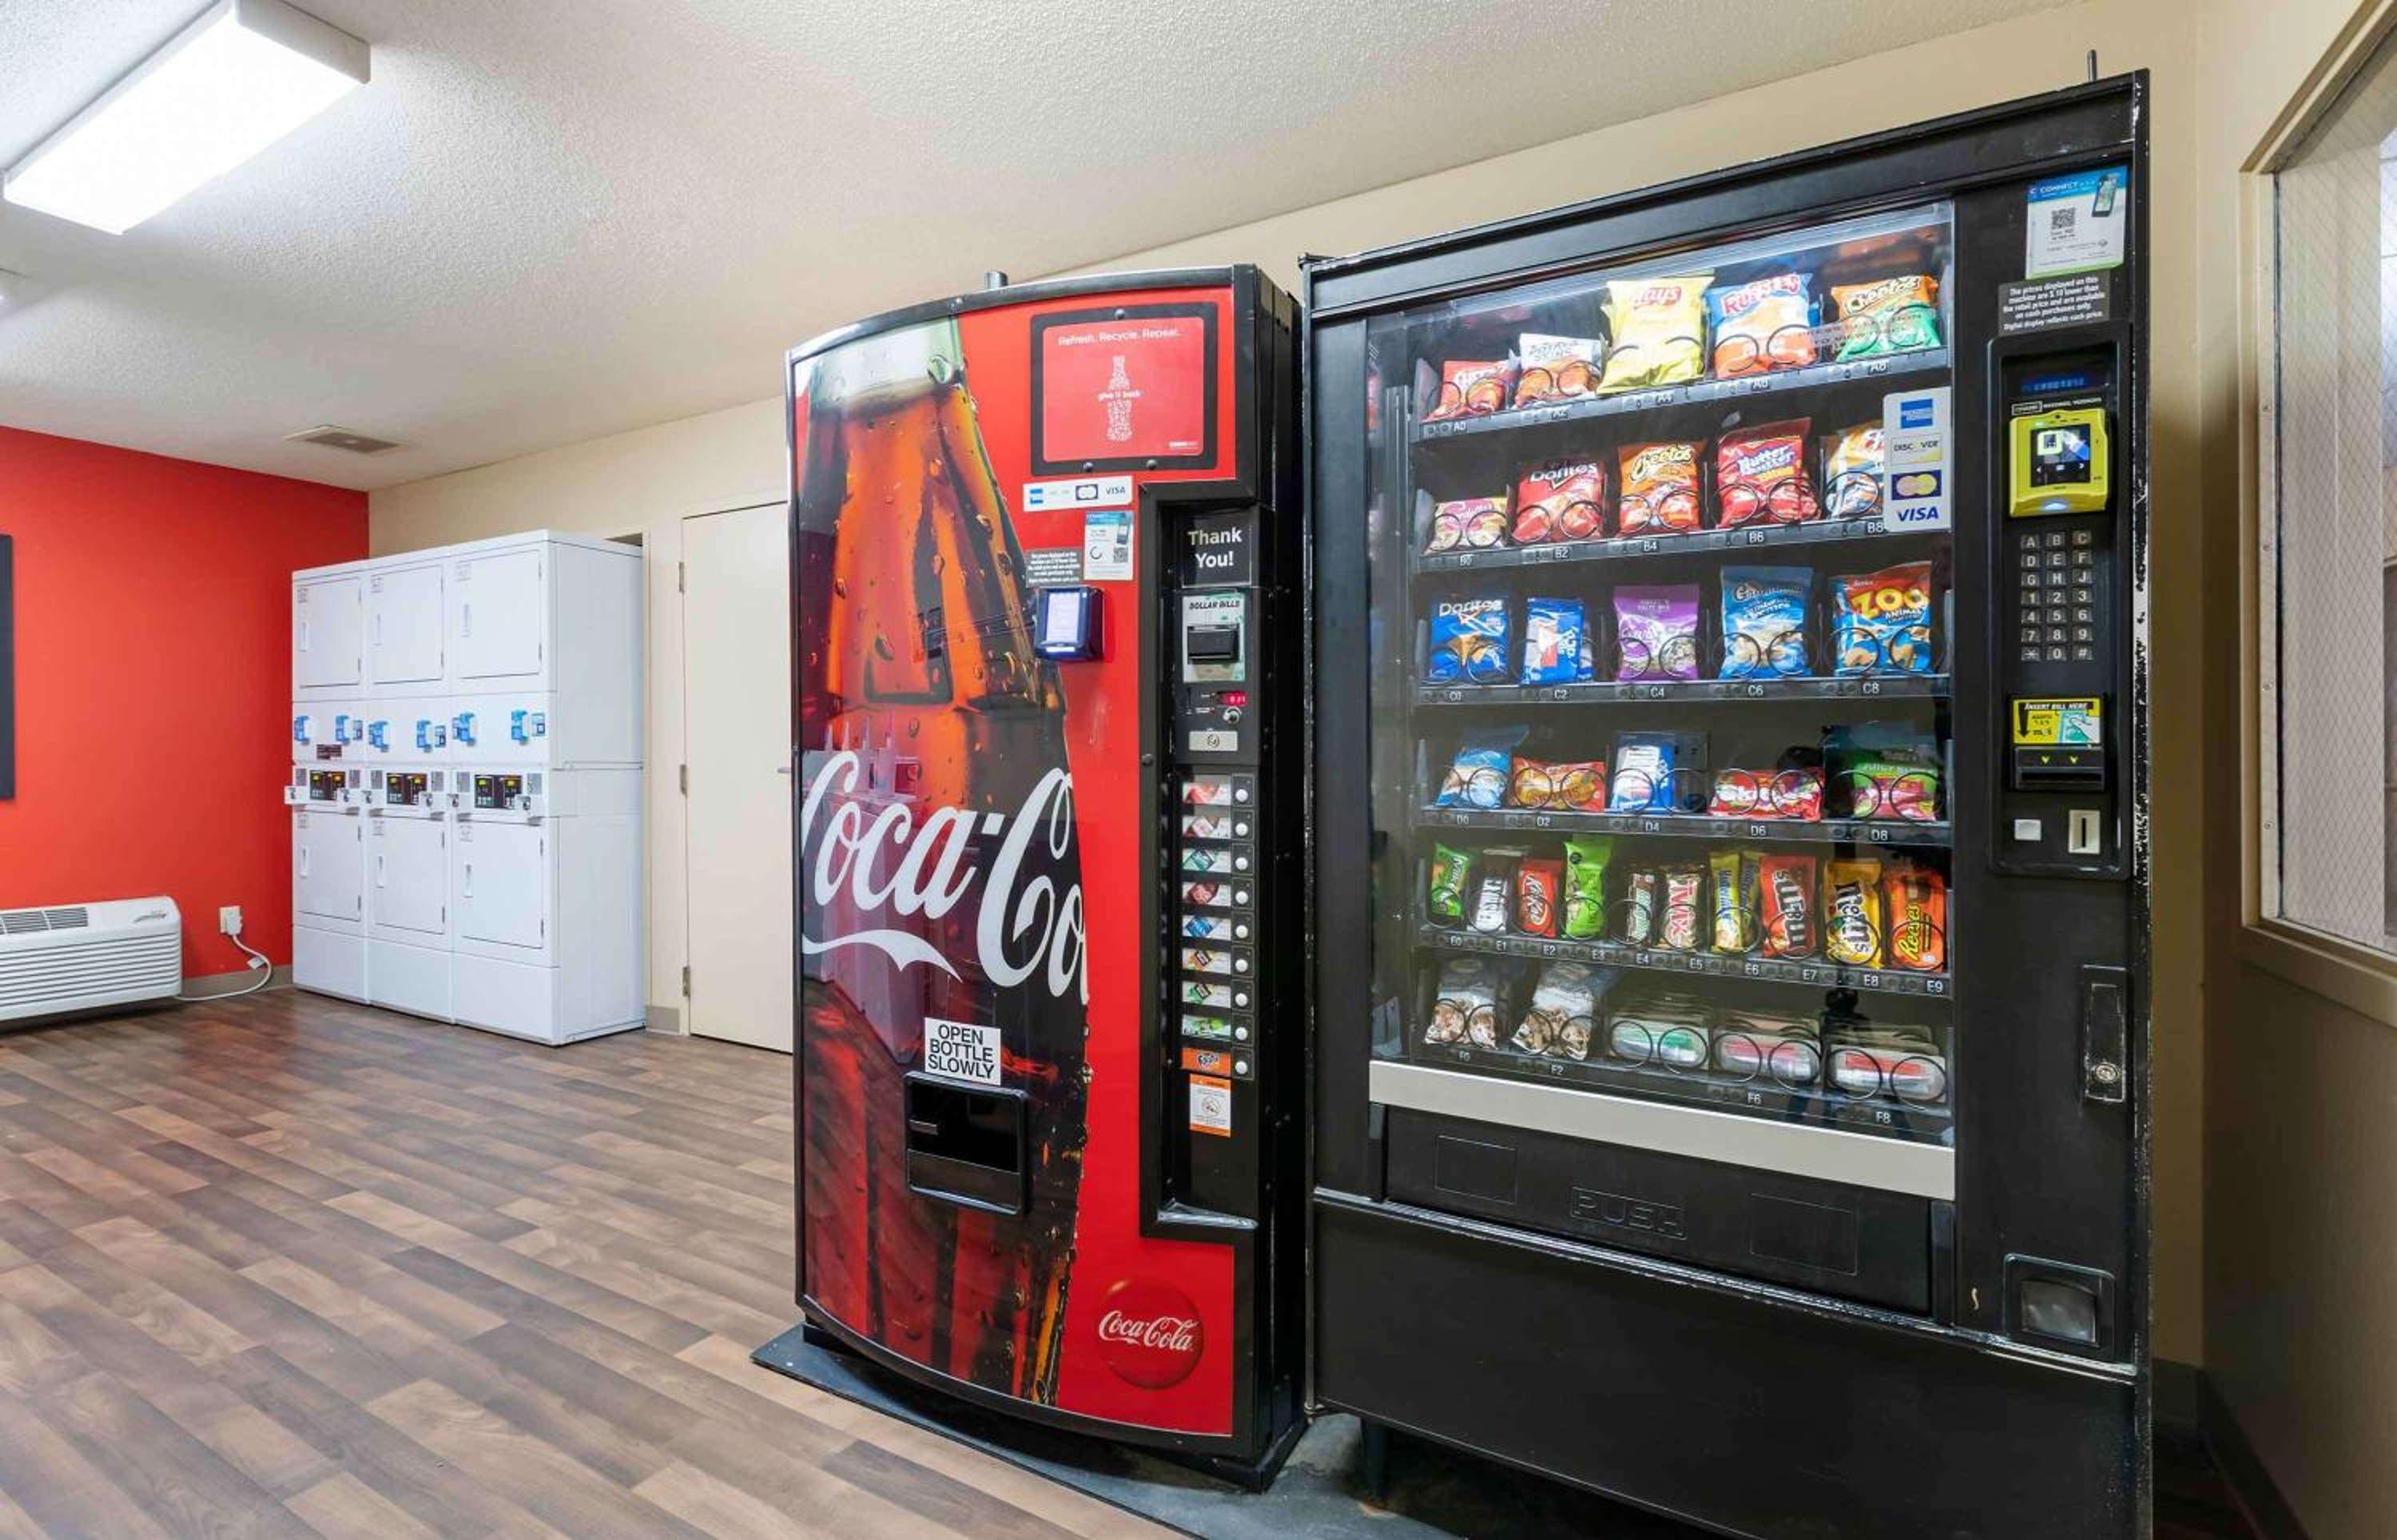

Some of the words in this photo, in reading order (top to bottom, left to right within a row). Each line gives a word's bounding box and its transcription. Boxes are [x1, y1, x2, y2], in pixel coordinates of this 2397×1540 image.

[1059, 334, 1095, 346] Refresh.
[1099, 331, 1140, 343] Recycle.
[1142, 328, 1181, 339] Repeat.
[1631, 445, 1694, 482] Cheetos
[1529, 462, 1600, 482] Doritos
[1106, 486, 1126, 495] VISA
[1898, 506, 1940, 522] VISA
[1187, 526, 1242, 546] Thank
[2027, 537, 2036, 548] A
[2053, 534, 2061, 546] B
[2077, 533, 2087, 544] C
[1195, 550, 1234, 568] You!
[2027, 555, 2036, 567] D
[2053, 554, 2062, 566] E
[2078, 552, 2088, 563] F
[2027, 574, 2036, 585] G
[2053, 573, 2062, 585] H
[2078, 571, 2086, 582] J
[2030, 593, 2036, 604] 1
[2053, 592, 2061, 603] 2
[2078, 590, 2086, 601] 3
[1189, 601, 1218, 610] DOLLAR
[1219, 600, 1241, 609] BILLS
[1439, 599, 1503, 617] Doritos
[1851, 588, 1930, 619] ZOO
[2027, 611, 2036, 622] 4
[2053, 610, 2061, 621] 5
[2078, 609, 2088, 621] 6
[2027, 630, 2036, 641] 7
[2053, 629, 2061, 640] 8
[2078, 628, 2087, 640] 9
[2053, 648, 2062, 659] 0
[1554, 689, 1568, 699] C2
[1650, 689, 1664, 698] C4
[1747, 685, 1763, 696] C6
[1862, 683, 1879, 694] C8
[1536, 817, 1551, 827] D2
[1645, 821, 1660, 832] D4
[1751, 826, 1767, 836] D6
[1870, 830, 1888, 841] D8
[1496, 941, 1506, 951] E1
[1543, 945, 1556, 955] E2
[1636, 953, 1649, 964] E4
[1690, 960, 1703, 970] E5
[1745, 964, 1759, 976] E6
[1803, 970, 1817, 981] E7
[1864, 974, 1878, 986] E8
[1926, 981, 1943, 993] E9
[938, 1024, 984, 1046] OPEN
[929, 1038, 993, 1063] BOTTLE
[928, 1054, 995, 1079] SLOWLY
[1876, 1112, 1891, 1124] F8
[1099, 1309, 1198, 1351] Coca-Cola
